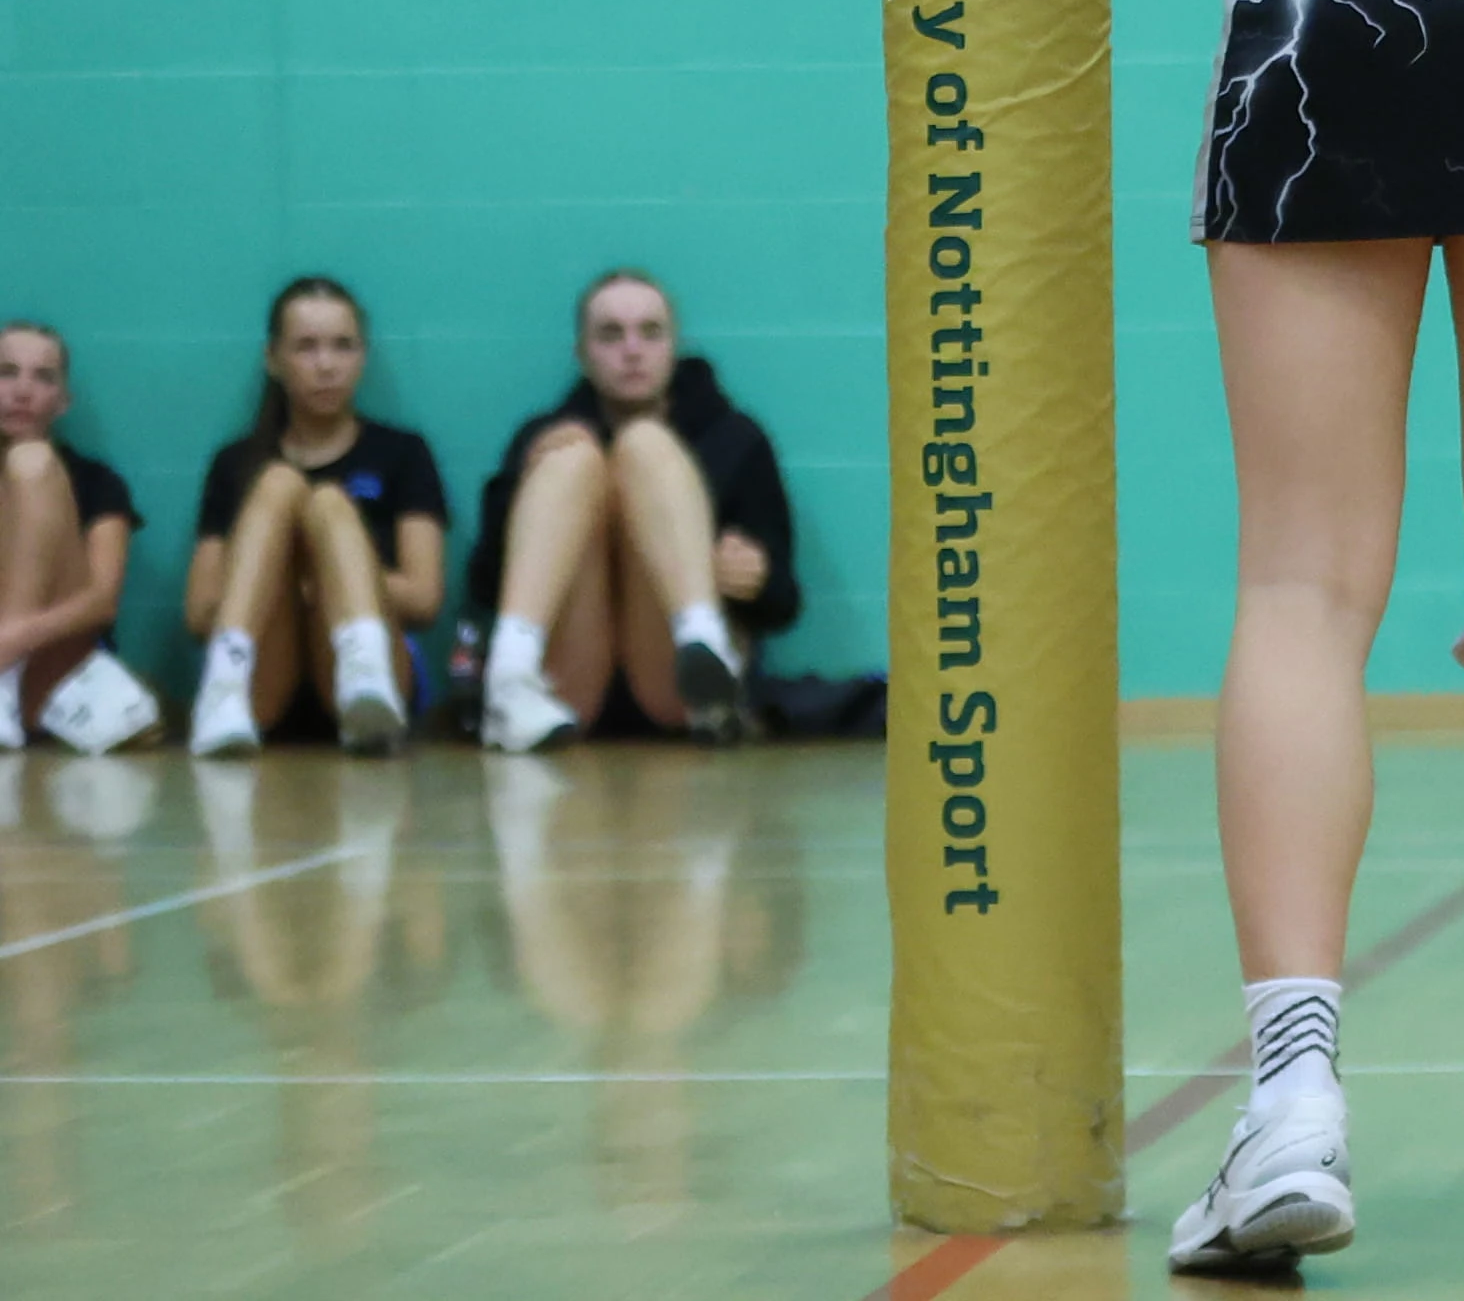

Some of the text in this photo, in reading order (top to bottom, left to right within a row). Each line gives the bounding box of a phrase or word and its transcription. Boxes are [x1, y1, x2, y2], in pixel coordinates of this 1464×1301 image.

[925, 72, 984, 151] of
[922, 172, 993, 670] Nottingham
[929, 691, 999, 915] Sport
